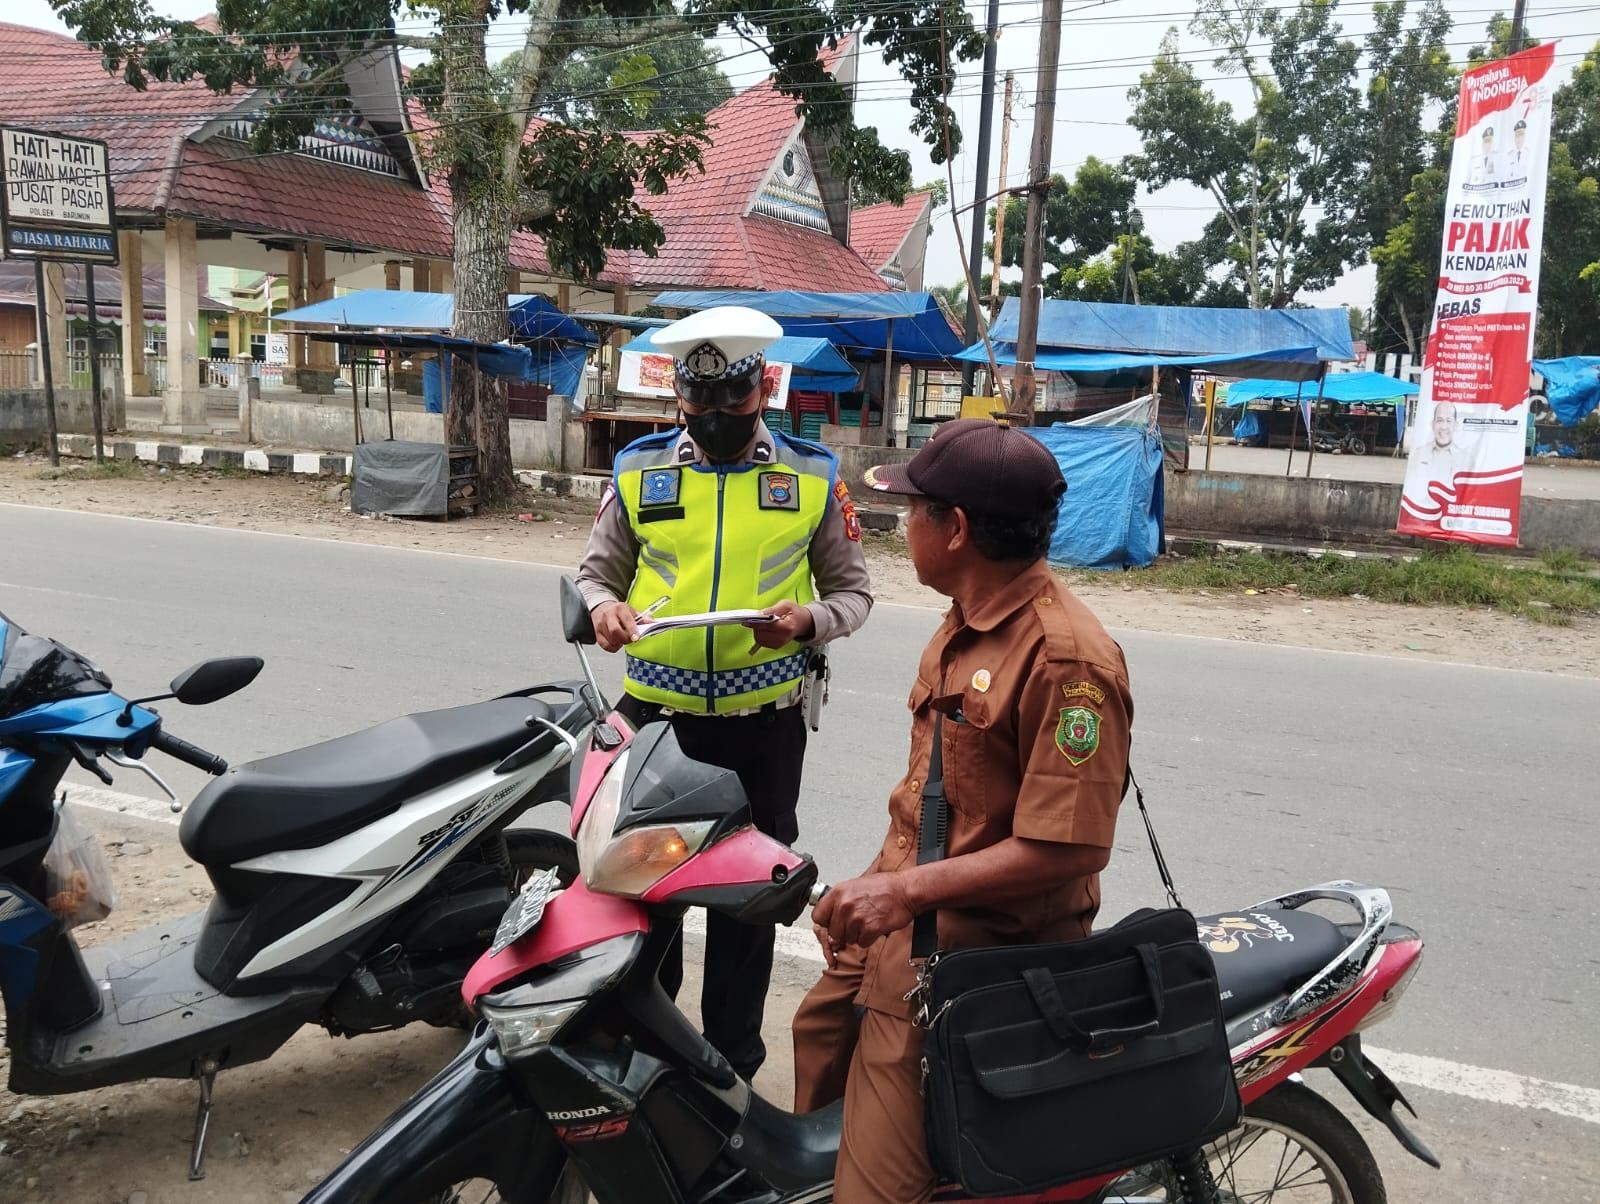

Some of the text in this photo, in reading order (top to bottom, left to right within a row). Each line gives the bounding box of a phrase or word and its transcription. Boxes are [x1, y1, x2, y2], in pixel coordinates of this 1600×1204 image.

[1472, 75, 1528, 103] INDONESIA
[13, 134, 95, 166] HATI-HATI
[9, 157, 101, 189] RAWAN MACET
[11, 182, 104, 210] PUSAT PASAR
[23, 231, 110, 250] JASA RAHARJA
[1447, 218, 1531, 252] PAJAK
[1445, 253, 1528, 271] KENDARAAN
[1249, 912, 1295, 942] JERRY
[546, 1105, 612, 1120] HONDA
